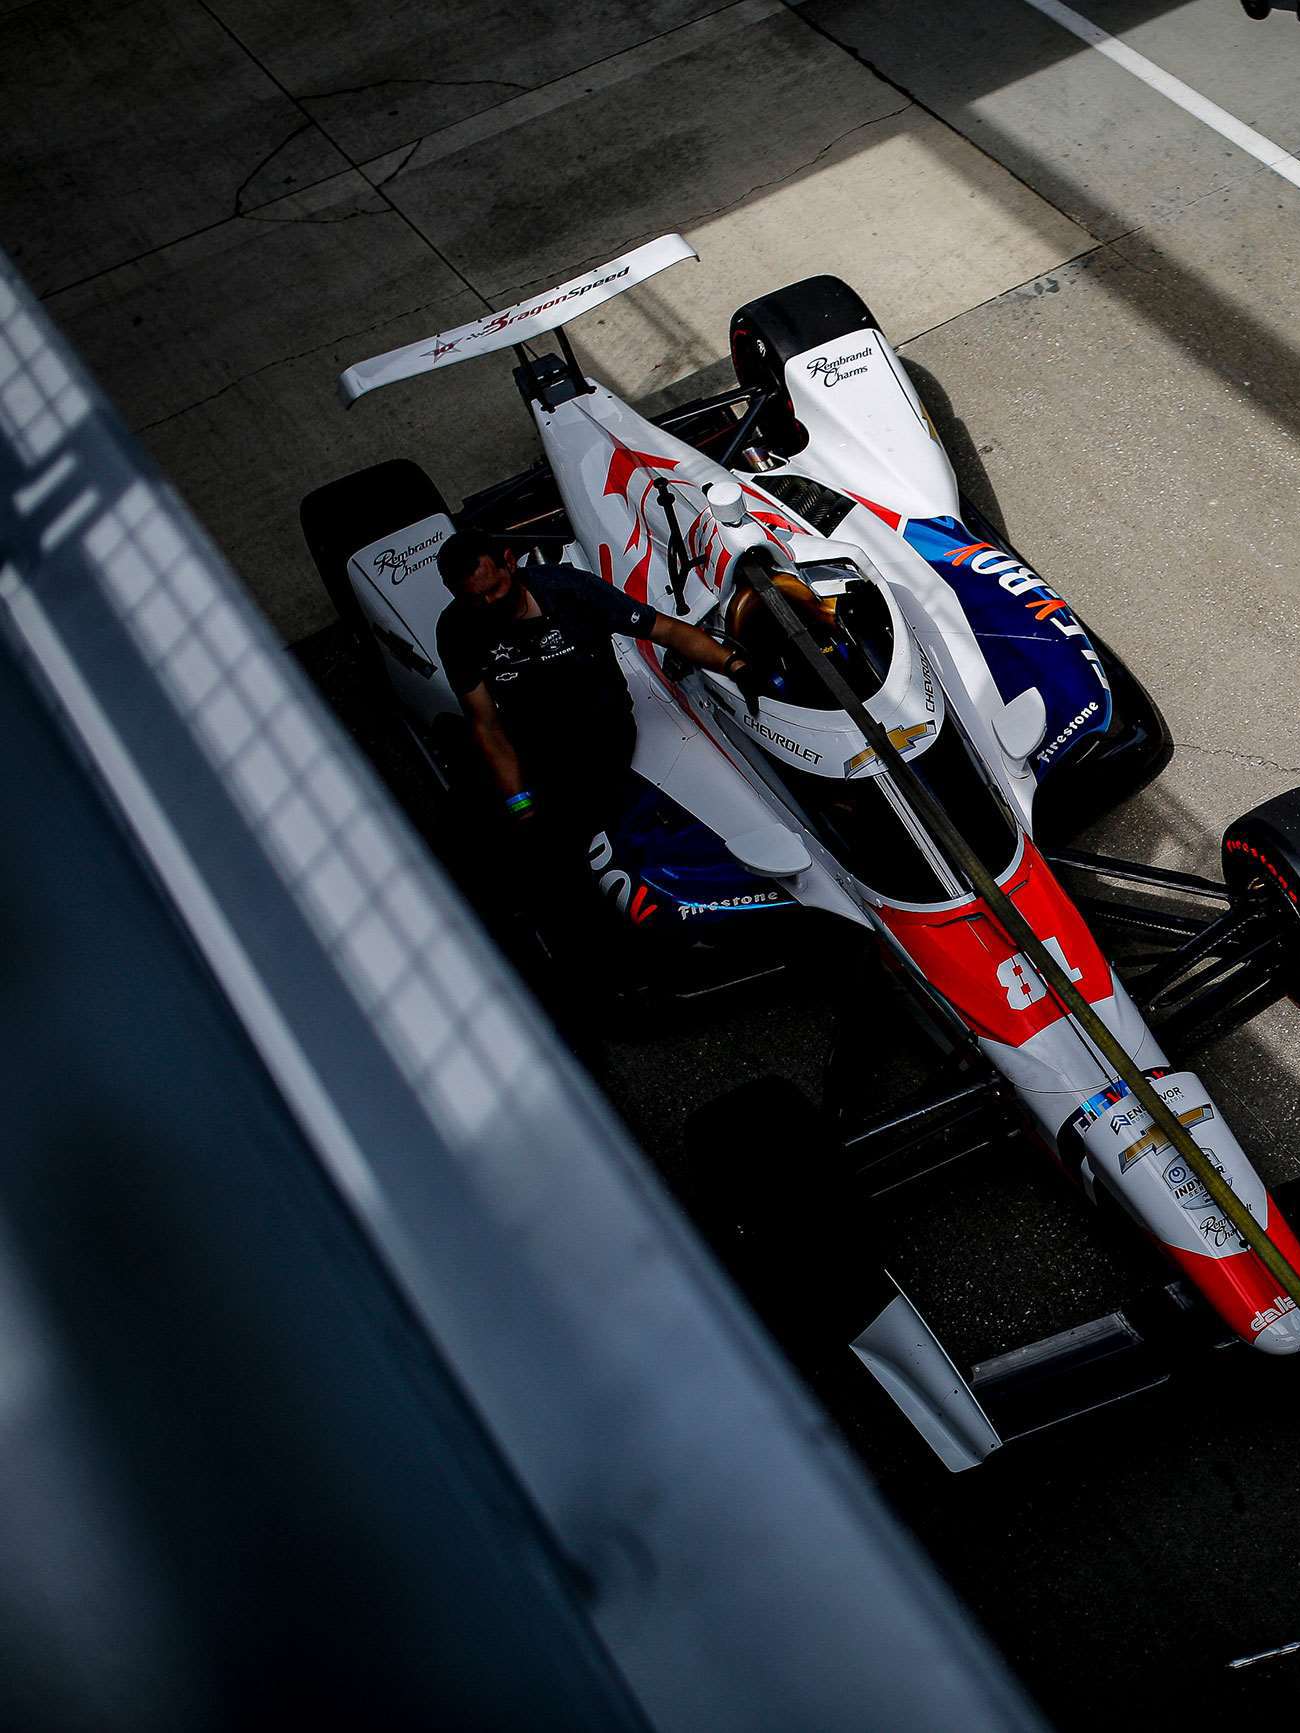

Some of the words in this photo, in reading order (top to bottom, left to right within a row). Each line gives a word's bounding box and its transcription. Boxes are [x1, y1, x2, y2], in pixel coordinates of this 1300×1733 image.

[806, 347, 878, 378] Rembrandt
[824, 365, 868, 388] Charms
[374, 531, 442, 575] Rembrandt
[743, 715, 823, 764] CHEVROLET
[1037, 701, 1099, 763] Firestone
[677, 891, 779, 920] Firestone
